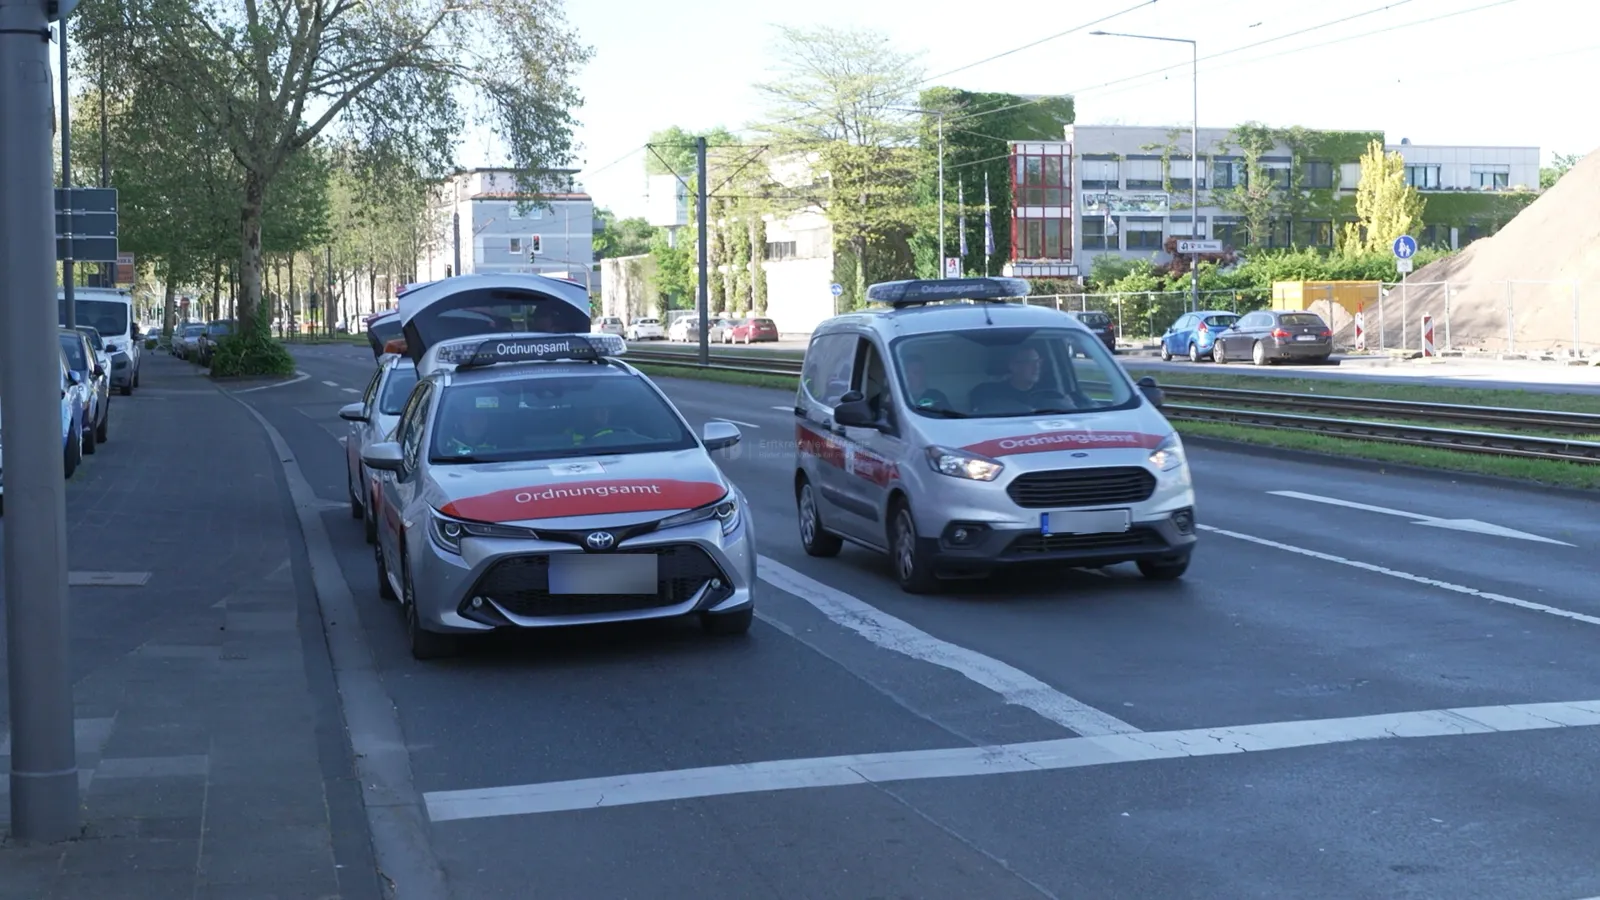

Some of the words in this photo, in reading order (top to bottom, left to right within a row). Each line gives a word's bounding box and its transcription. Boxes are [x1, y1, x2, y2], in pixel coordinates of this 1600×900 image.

[921, 284, 984, 295] Ordnungsamt
[496, 340, 570, 356] Ordnungsamt
[999, 434, 1138, 449] Ordnungsamt
[515, 484, 661, 504] Ordnungsamt
